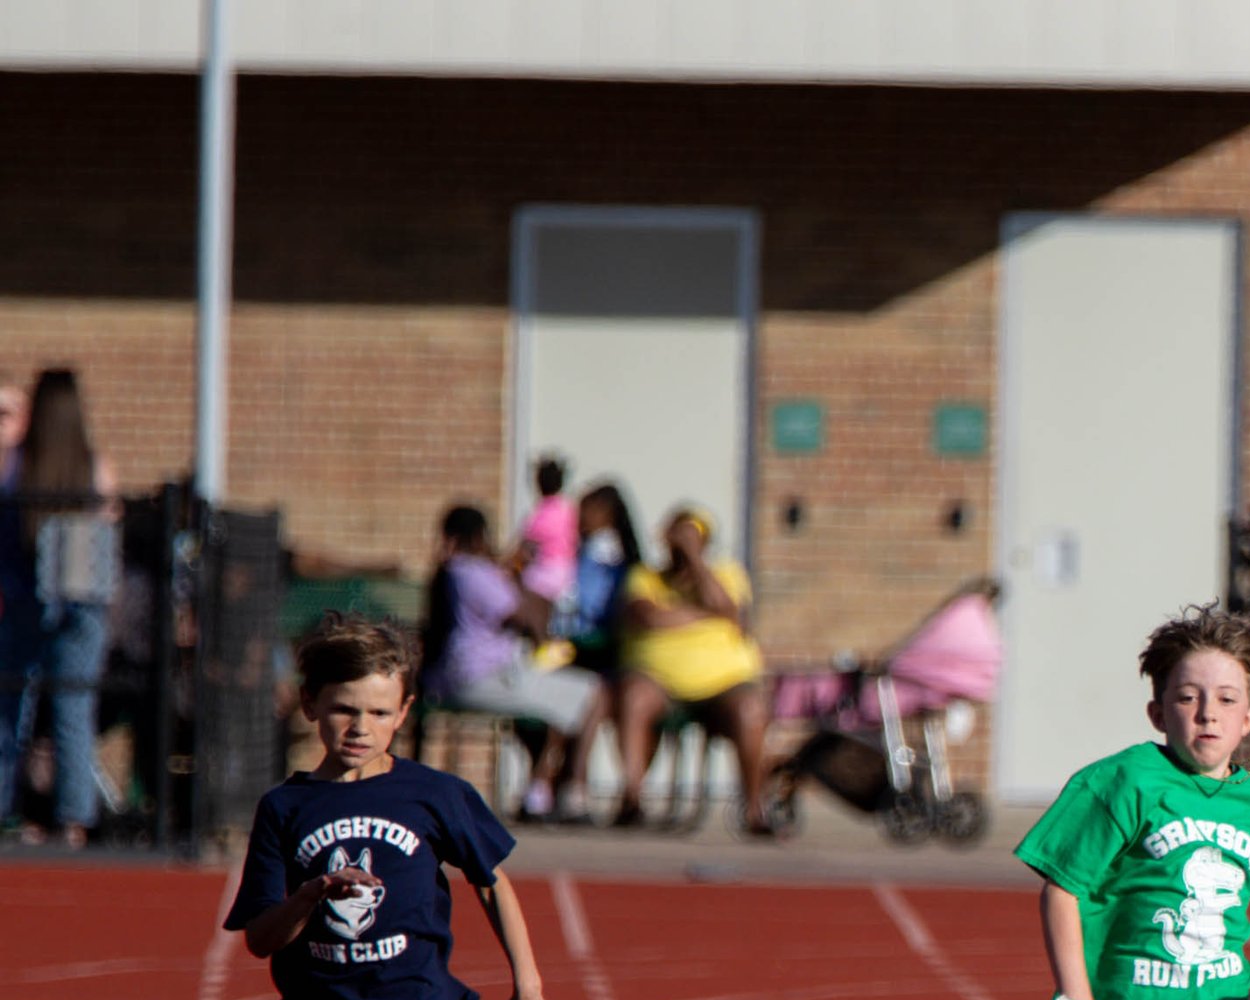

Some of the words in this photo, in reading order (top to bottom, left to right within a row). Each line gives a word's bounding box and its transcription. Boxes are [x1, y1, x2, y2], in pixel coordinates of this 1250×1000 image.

[295, 816, 420, 868] HOUGHTON
[309, 941, 347, 963] RUN
[350, 934, 407, 963] CLUB
[1132, 957, 1191, 989] RUN
